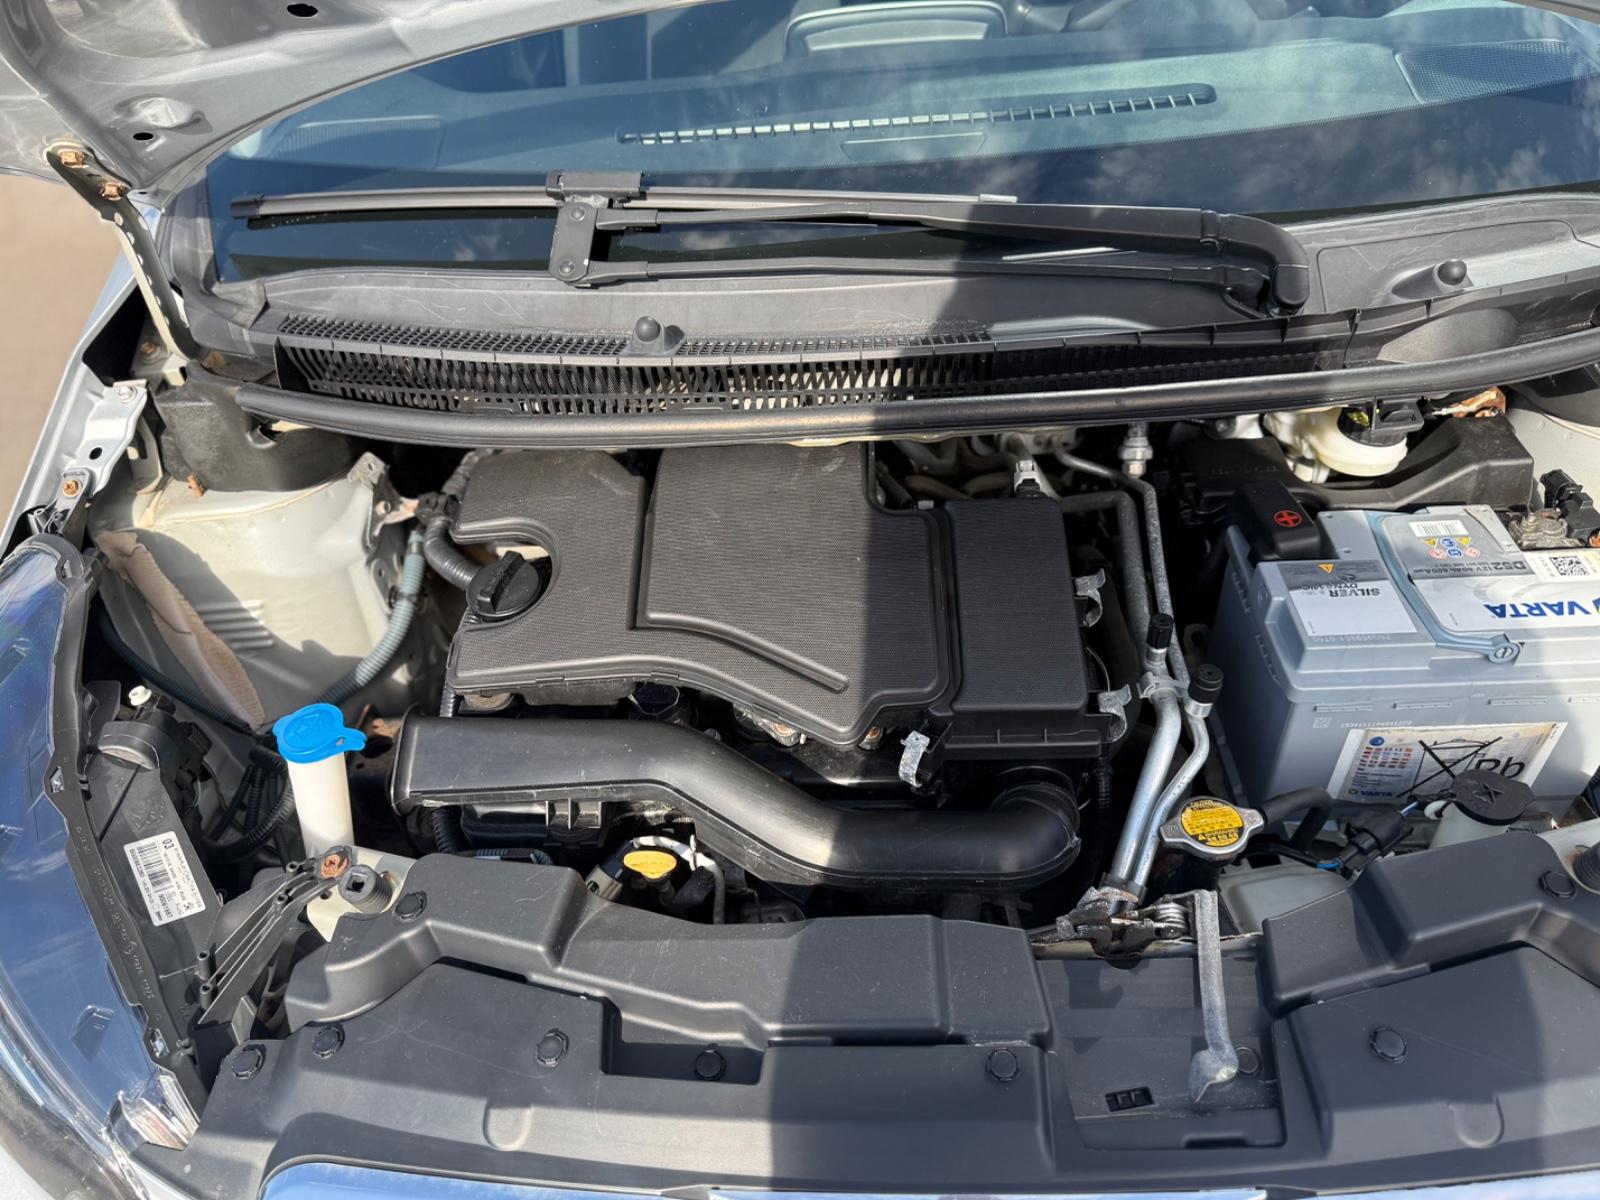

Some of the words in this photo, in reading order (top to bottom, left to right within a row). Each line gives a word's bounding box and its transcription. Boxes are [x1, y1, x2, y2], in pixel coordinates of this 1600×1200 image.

[1491, 560, 1527, 570] D52
[1329, 587, 1380, 597] SILVER
[1483, 600, 1591, 618] VARTA
[1360, 790, 1392, 798] VARTA
[162, 838, 175, 849] 03
